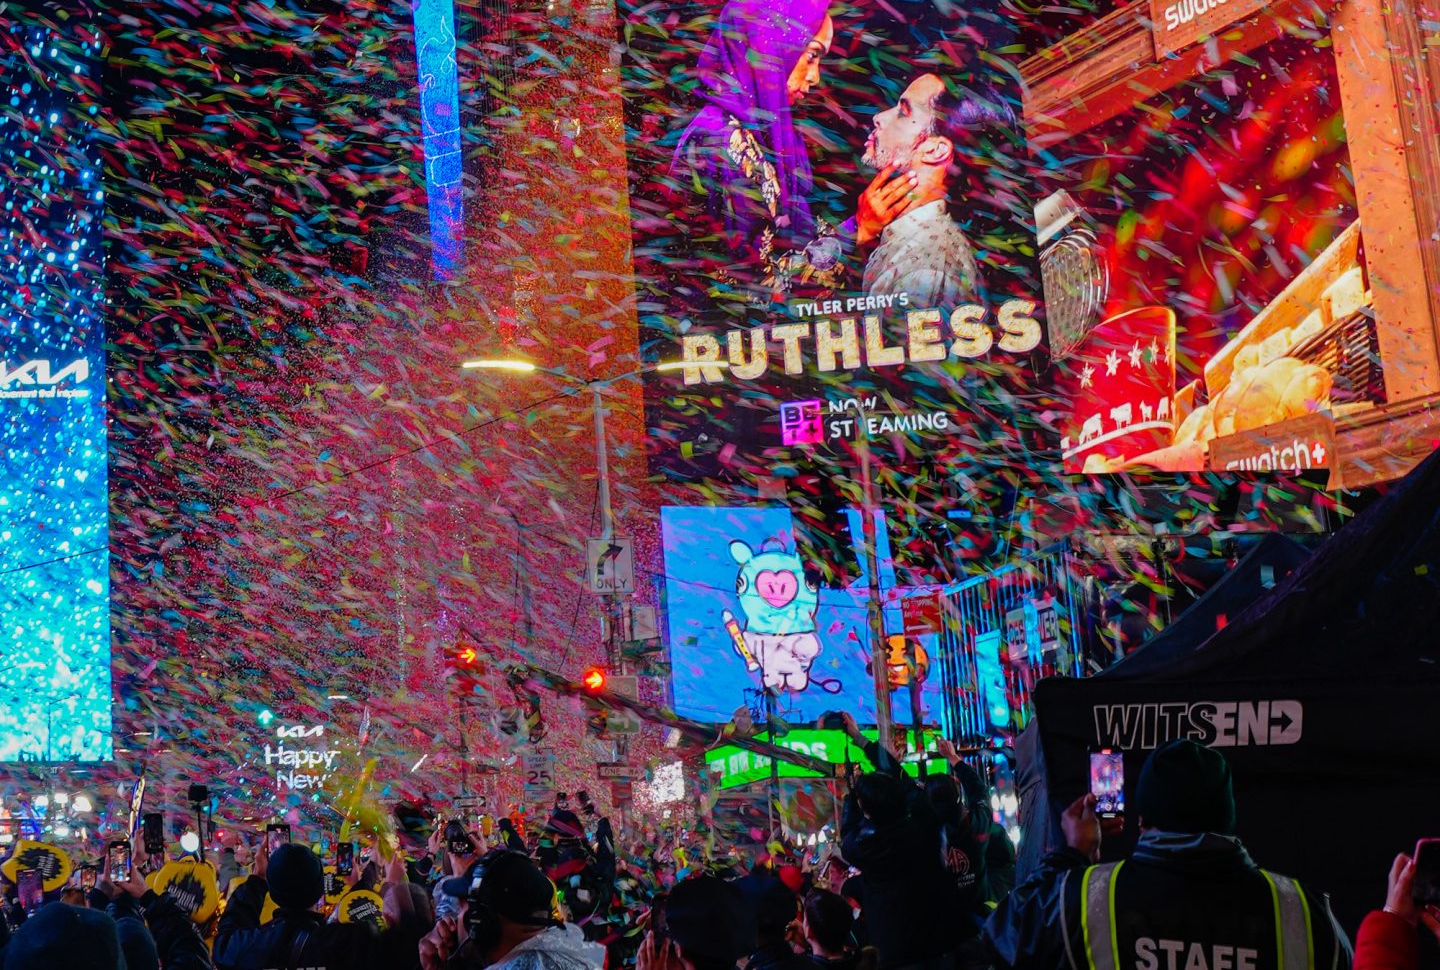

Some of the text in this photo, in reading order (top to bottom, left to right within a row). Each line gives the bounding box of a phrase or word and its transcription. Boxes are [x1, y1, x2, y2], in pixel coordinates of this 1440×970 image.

[796, 292, 909, 318] TYLER PERRY'S
[682, 299, 1043, 386] RUTHLESS
[831, 412, 949, 438] STEAMING
[596, 578, 627, 590] ONLY
[264, 744, 339, 770] Happy
[276, 770, 328, 791] New
[527, 770, 552, 786] 25
[604, 766, 621, 776] ONE
[1134, 936, 1258, 970] STAFF
